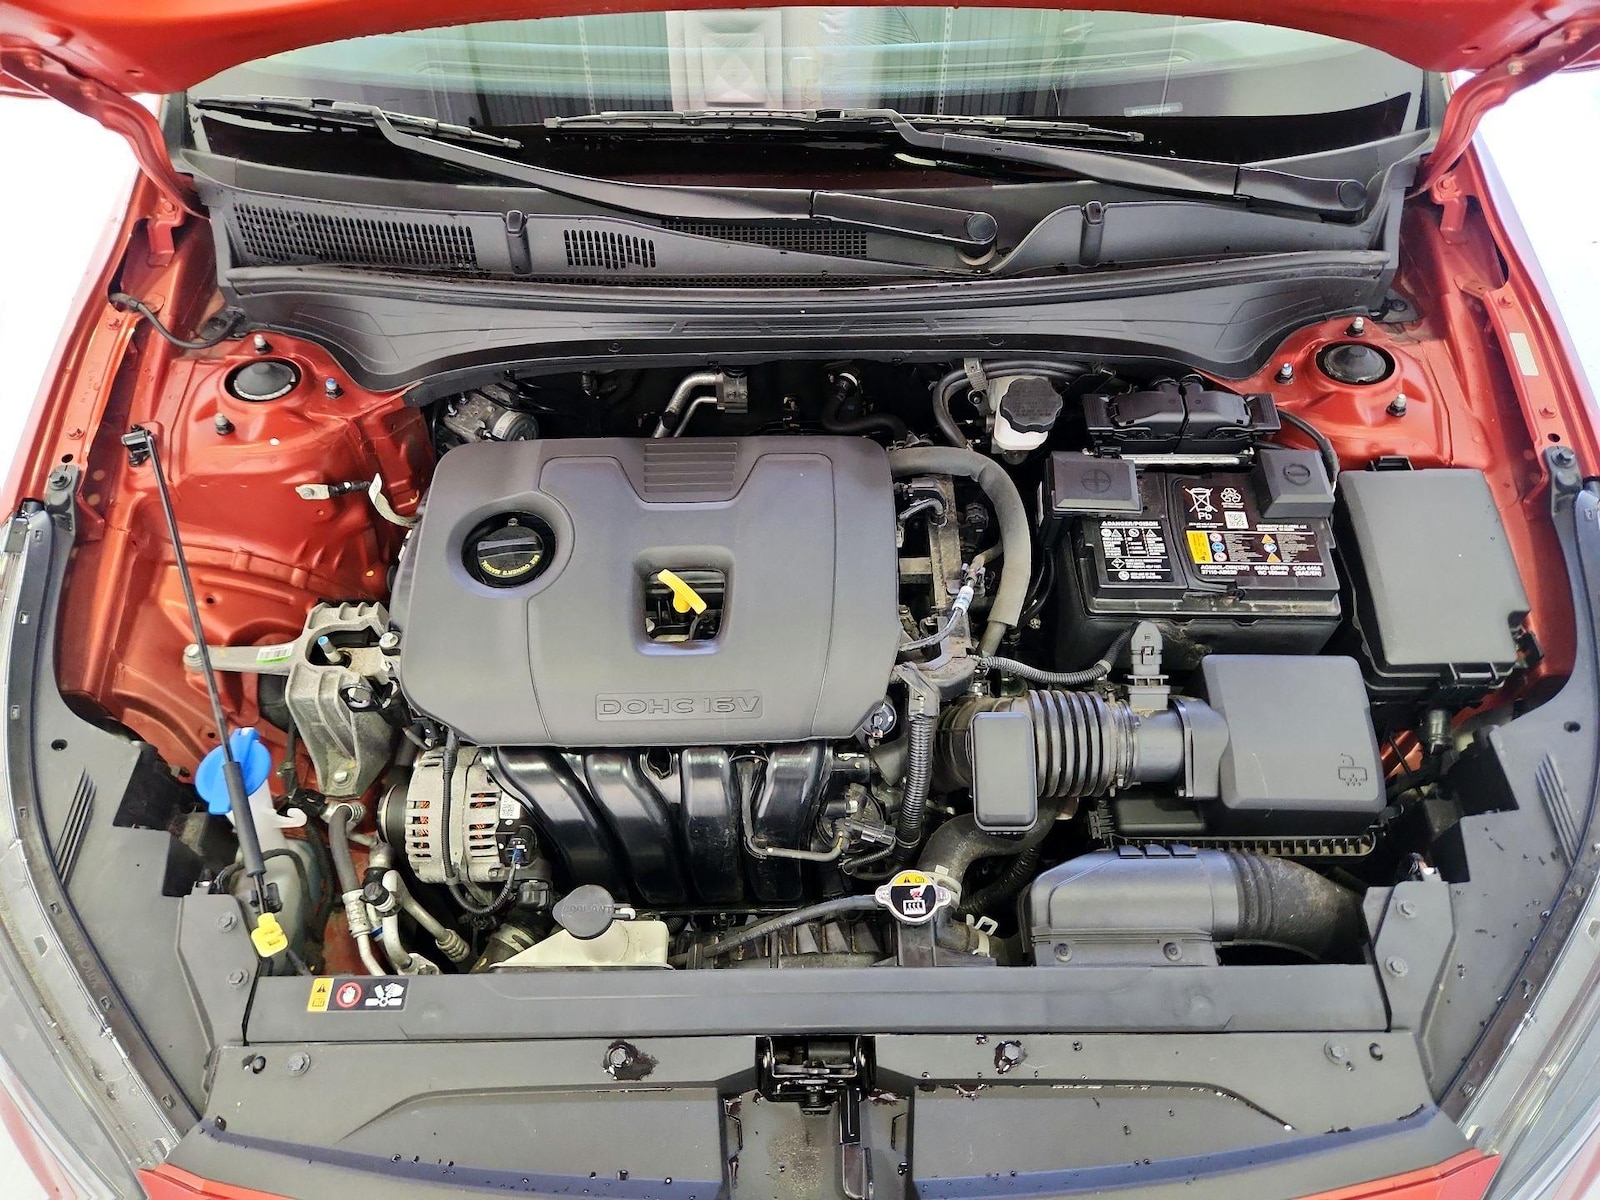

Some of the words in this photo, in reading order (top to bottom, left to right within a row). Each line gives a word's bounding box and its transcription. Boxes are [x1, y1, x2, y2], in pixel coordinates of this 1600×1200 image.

[1198, 512, 1212, 520] Pb
[599, 698, 694, 715] DOHC
[704, 696, 760, 713] 16V
